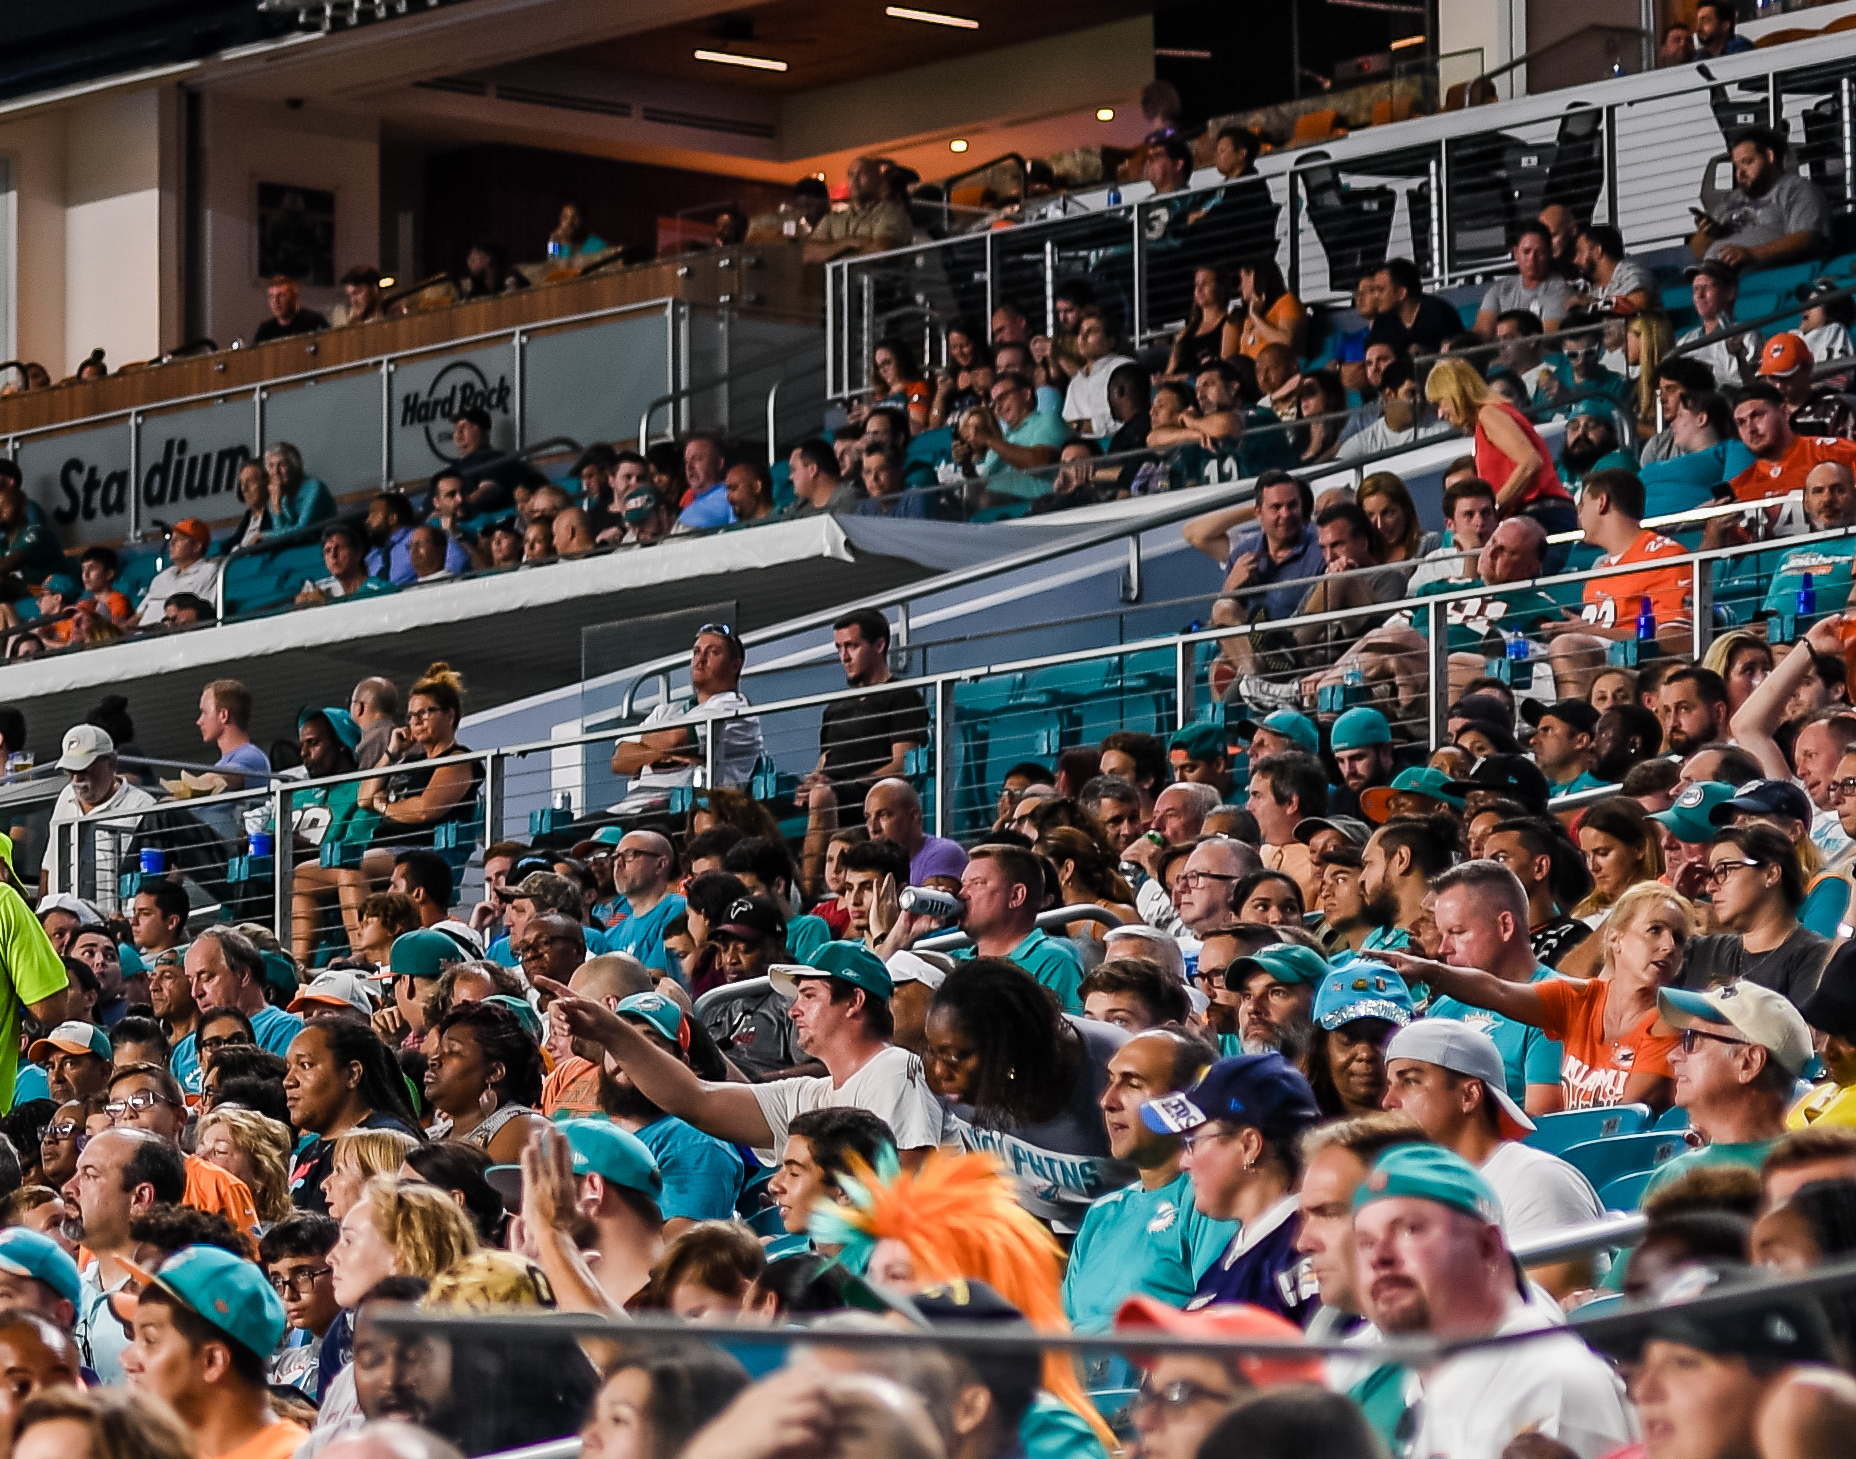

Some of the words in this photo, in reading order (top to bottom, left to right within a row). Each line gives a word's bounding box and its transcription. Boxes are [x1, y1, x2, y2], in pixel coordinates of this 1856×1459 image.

[401, 385, 456, 428] Hard
[459, 375, 511, 415] Rock
[52, 438, 251, 527] Stadium
